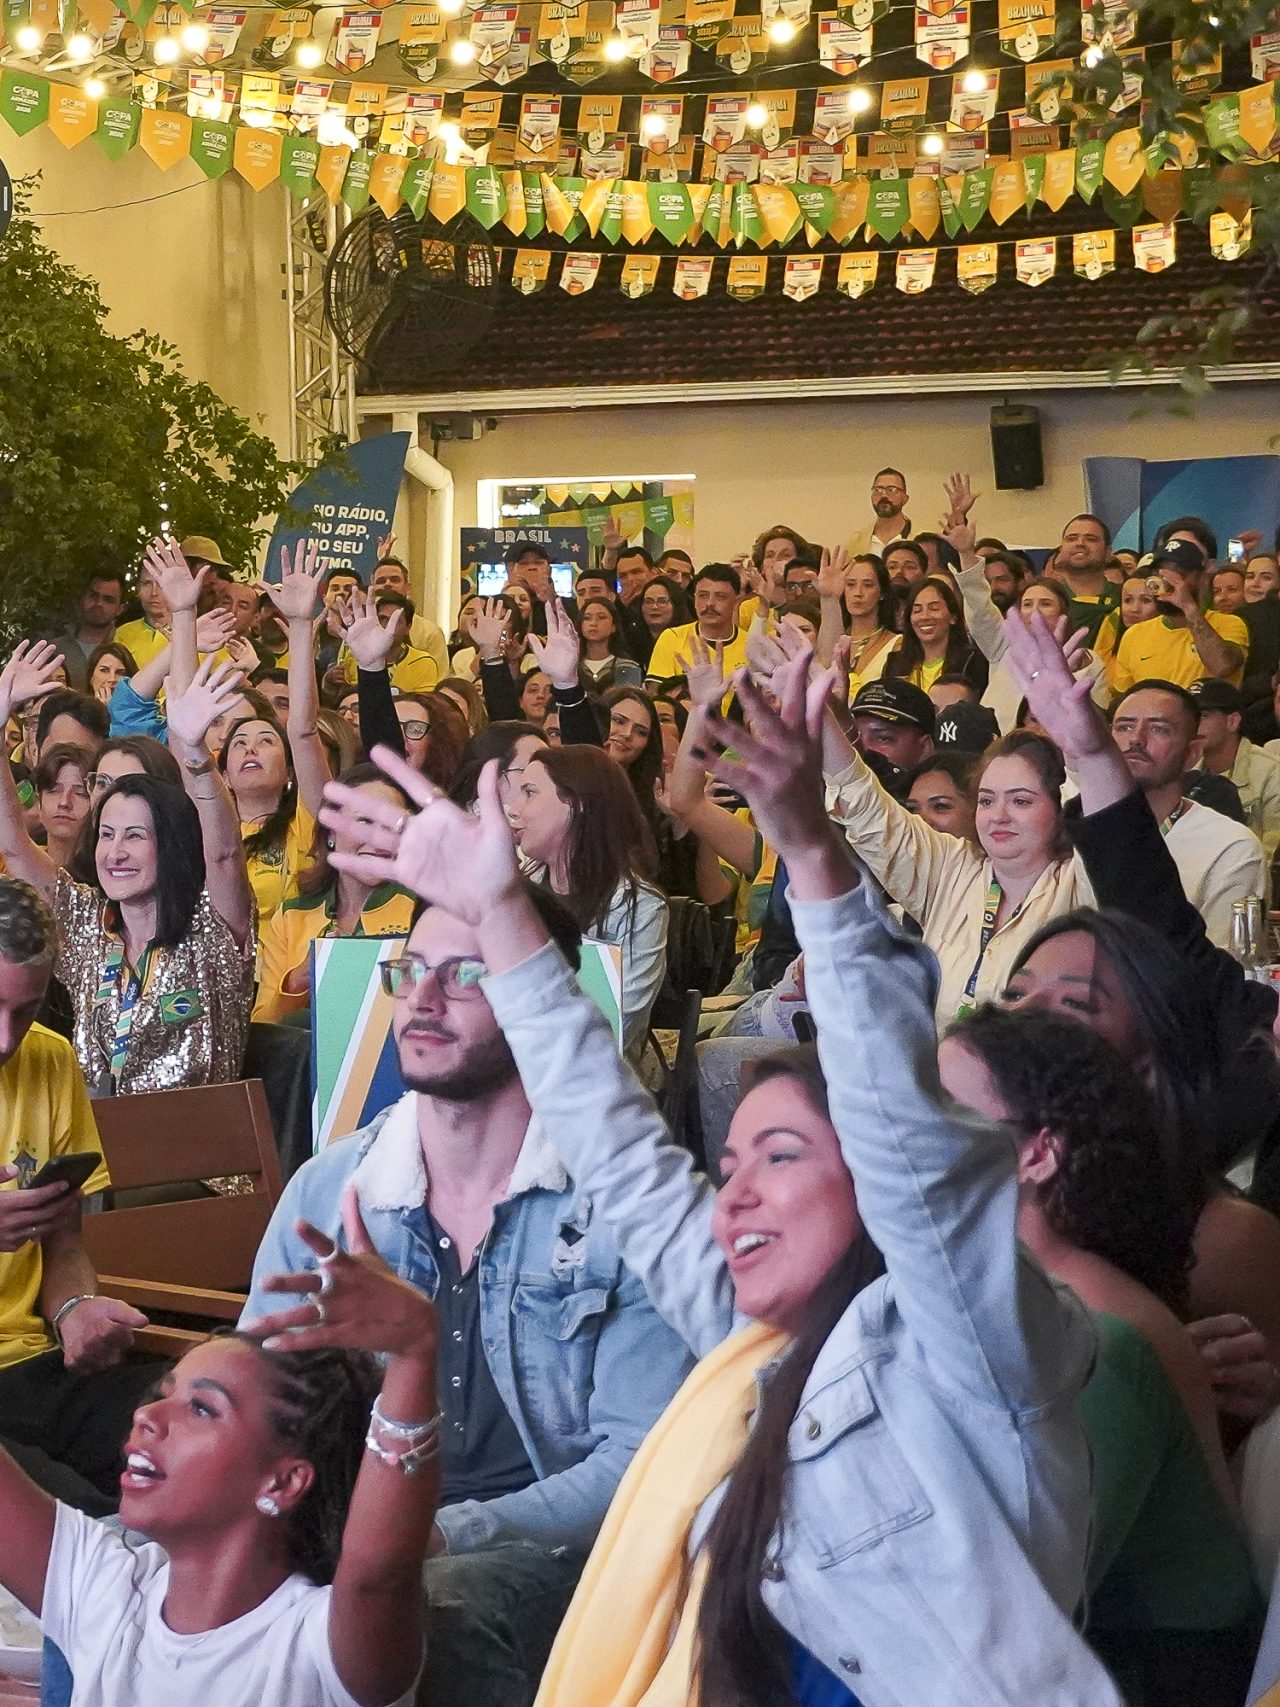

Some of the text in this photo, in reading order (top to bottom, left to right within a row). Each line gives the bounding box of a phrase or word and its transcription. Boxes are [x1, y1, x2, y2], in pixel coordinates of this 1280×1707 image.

[411, 12, 439, 26] BRAHMA
[1008, 5, 1044, 20] BRAHMA
[13, 86, 39, 98] COPA
[106, 110, 132, 121] COPA
[203, 131, 227, 144] COPA
[292, 150, 317, 162] COPA
[876, 192, 899, 200] COPA
[338, 503, 389, 525] RÁDIO,
[335, 523, 370, 540] APP,
[494, 530, 552, 543] BRASIL
[307, 538, 363, 554] NO SEU
